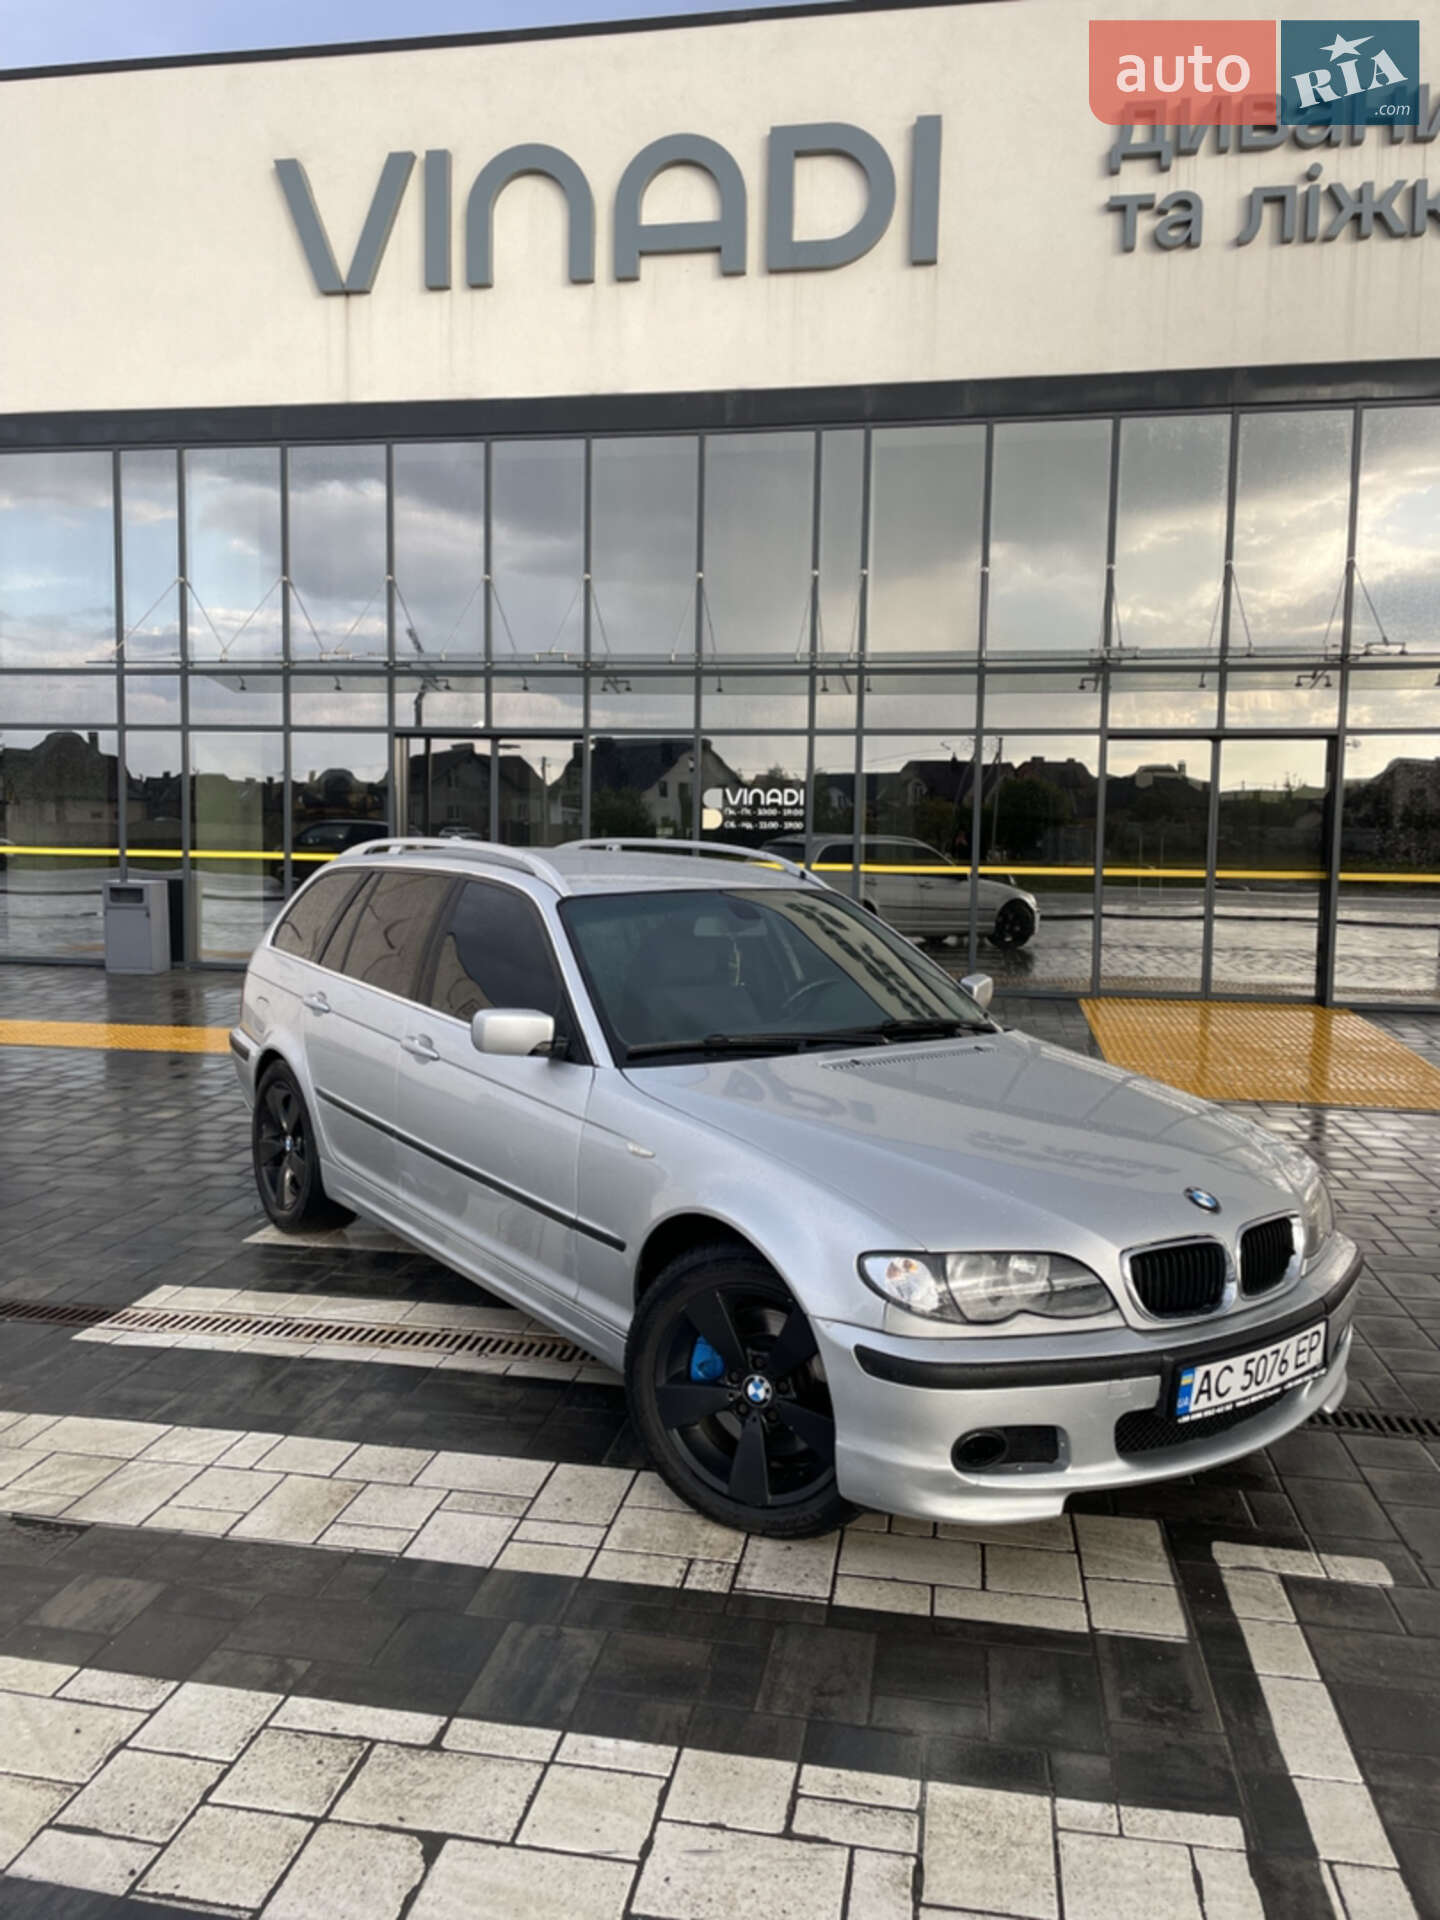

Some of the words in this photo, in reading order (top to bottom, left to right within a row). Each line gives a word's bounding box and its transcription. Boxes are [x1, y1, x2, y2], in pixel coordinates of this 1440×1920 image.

[274, 115, 942, 295] VINADI
[1107, 190, 1203, 252] та
[725, 788, 804, 806] VINADI
[1194, 1365, 1233, 1405] AC
[1241, 1345, 1289, 1392] 5076
[1295, 1330, 1321, 1370] EP
